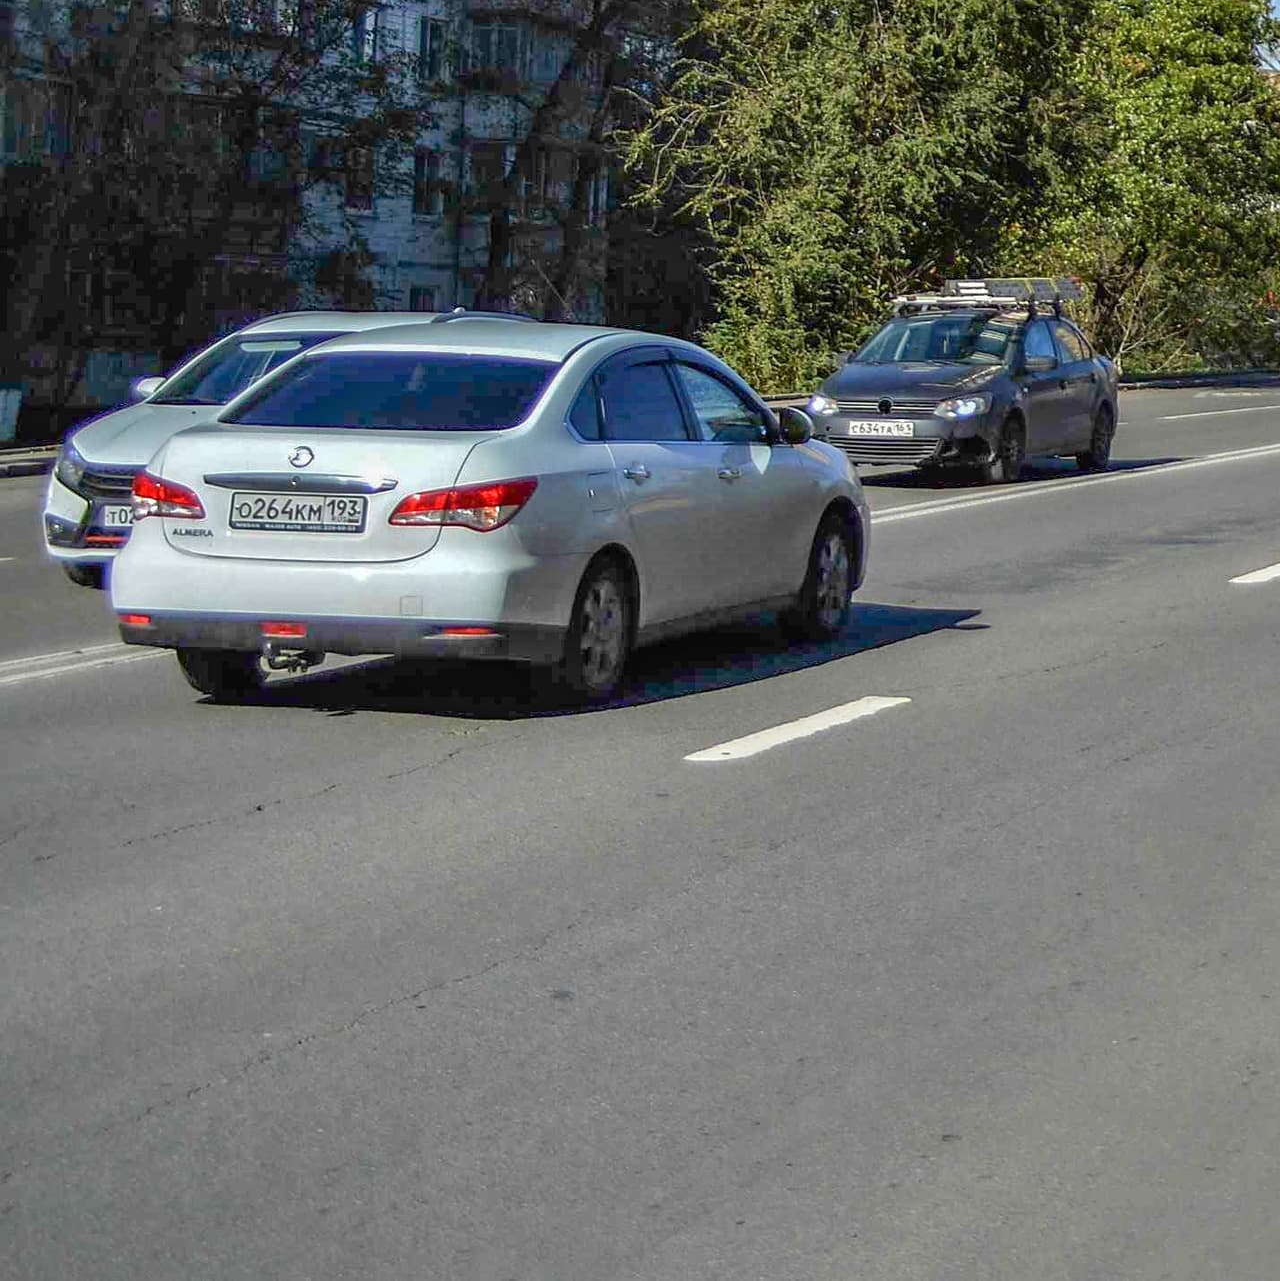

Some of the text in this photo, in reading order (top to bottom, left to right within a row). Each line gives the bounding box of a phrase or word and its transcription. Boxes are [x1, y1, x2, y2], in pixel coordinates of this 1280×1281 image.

[239, 497, 359, 522] О264КМ 193
[172, 528, 214, 538] ALMERA
